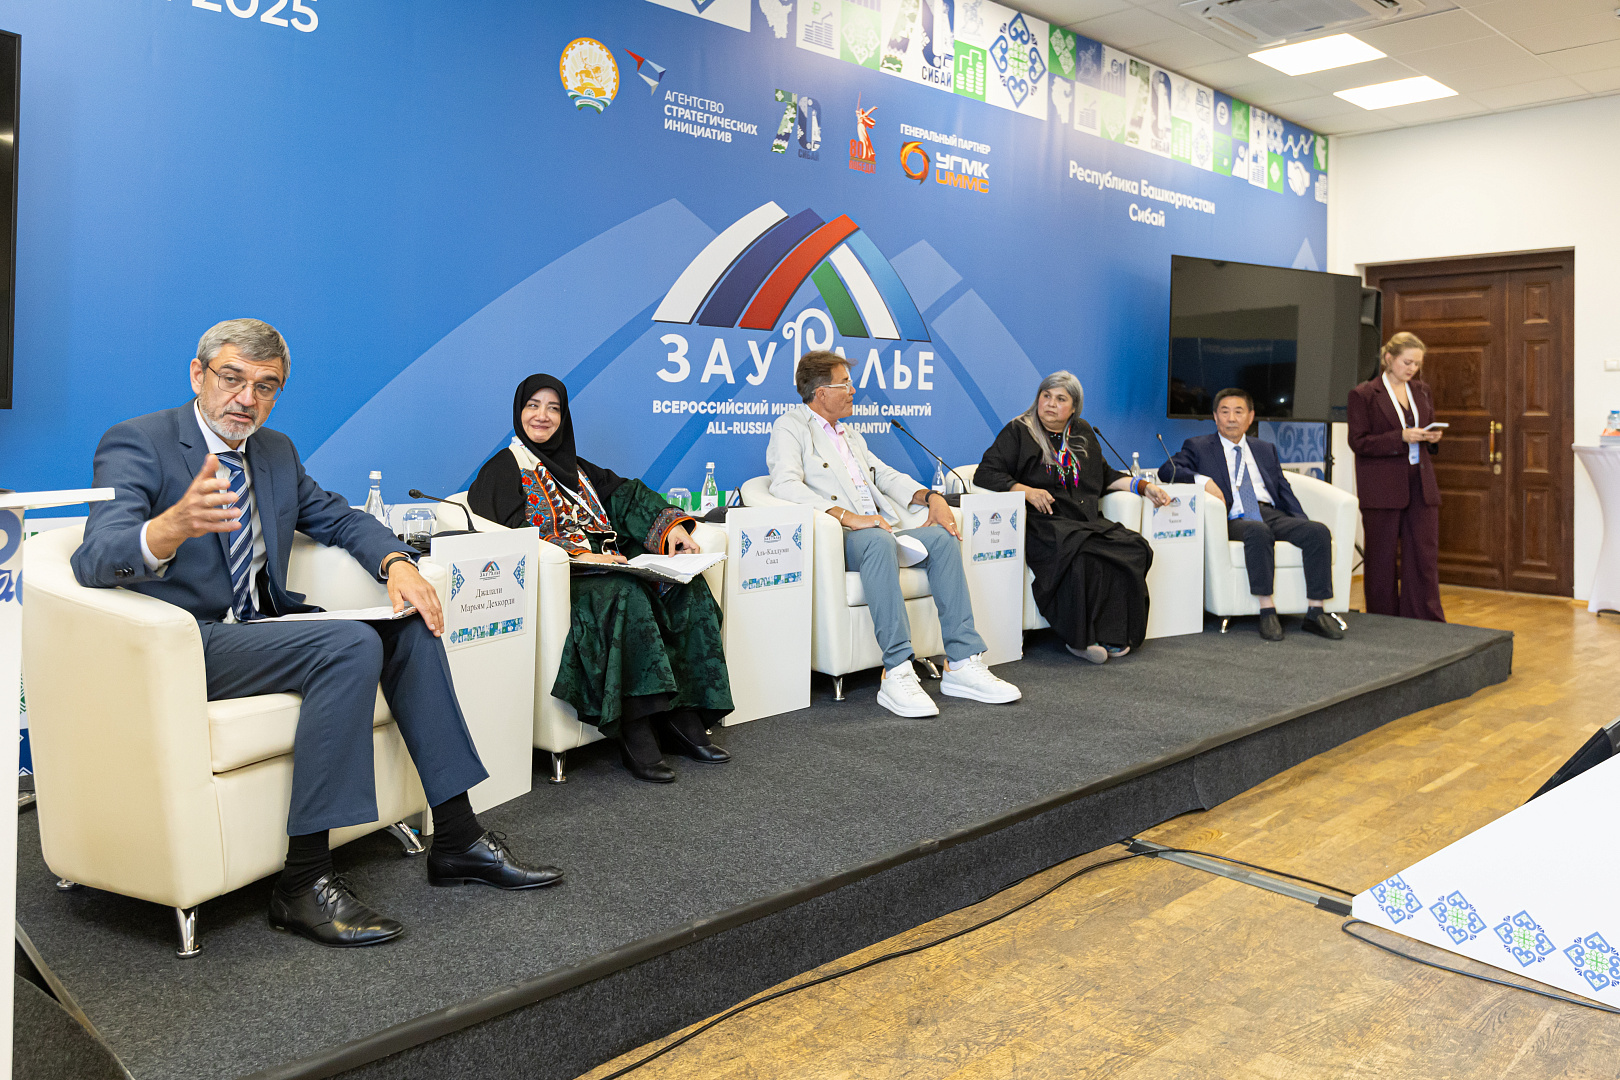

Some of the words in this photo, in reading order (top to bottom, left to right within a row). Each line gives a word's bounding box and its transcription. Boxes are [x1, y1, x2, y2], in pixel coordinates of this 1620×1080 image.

[922, 66, 952, 88] СИБАЙ
[664, 89, 725, 114] АГЕНТСТВО
[664, 104, 758, 136] СТРАТЕГИЧЕСКИХ
[664, 118, 733, 143] ИНИЦИАТИВ
[849, 138, 864, 159] 80
[900, 123, 957, 147] ГЕНЕРАЛЬНЫЙ
[957, 138, 991, 155] ПАРТНЕР
[935, 151, 990, 179] УГМК
[935, 168, 990, 194] UMMC
[1069, 160, 1139, 195] Республика
[1140, 179, 1216, 215] Башкортостан
[1128, 203, 1166, 227] Сибай
[652, 398, 769, 415] ВСЕРОССИЙСКИЙ
[880, 402, 932, 417] САБАНТУЙ
[706, 421, 773, 435] ALL-RUSSIA
[845, 422, 893, 434] ABANTUY
[475, 587, 503, 599] Джалали
[460, 602, 485, 614] Марьям
[485, 598, 515, 610] Дехкорди
